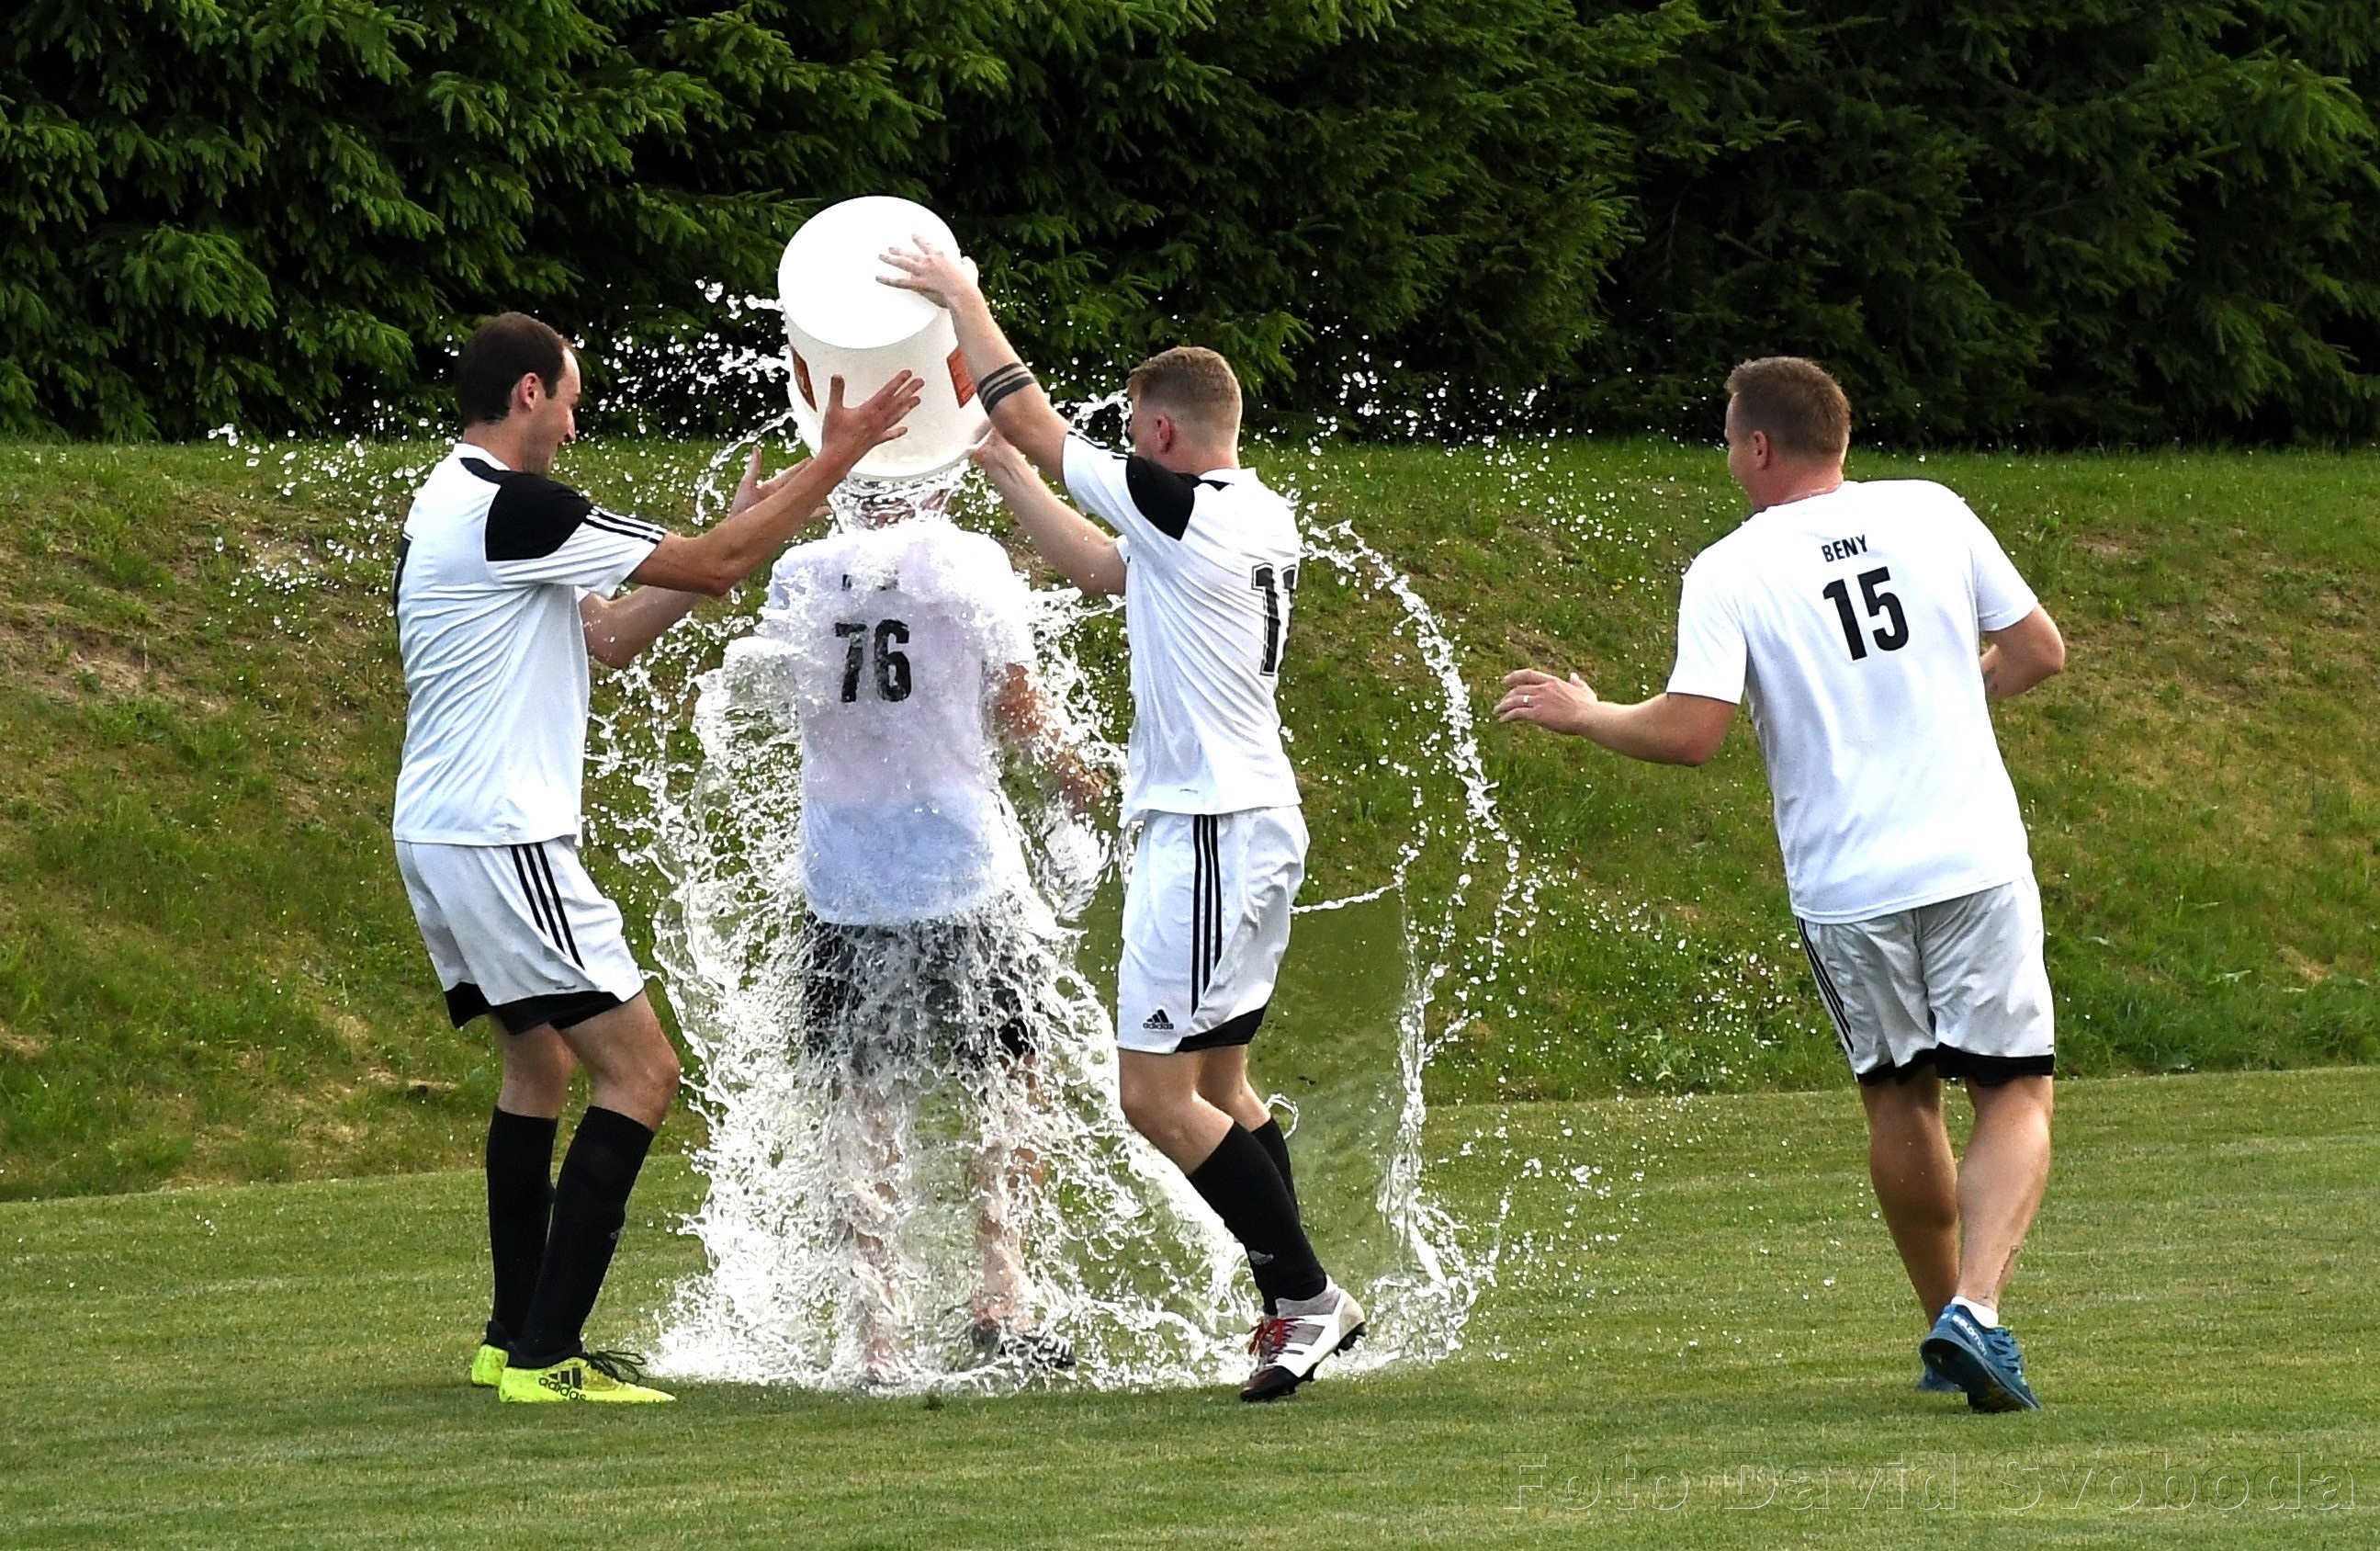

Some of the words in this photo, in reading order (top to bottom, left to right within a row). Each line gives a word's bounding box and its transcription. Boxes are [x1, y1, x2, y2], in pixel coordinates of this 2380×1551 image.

[1822, 534, 1867, 563] BENY
[1822, 566, 1909, 661] 15
[833, 618, 911, 703] 76
[538, 1376, 587, 1402] adidas
